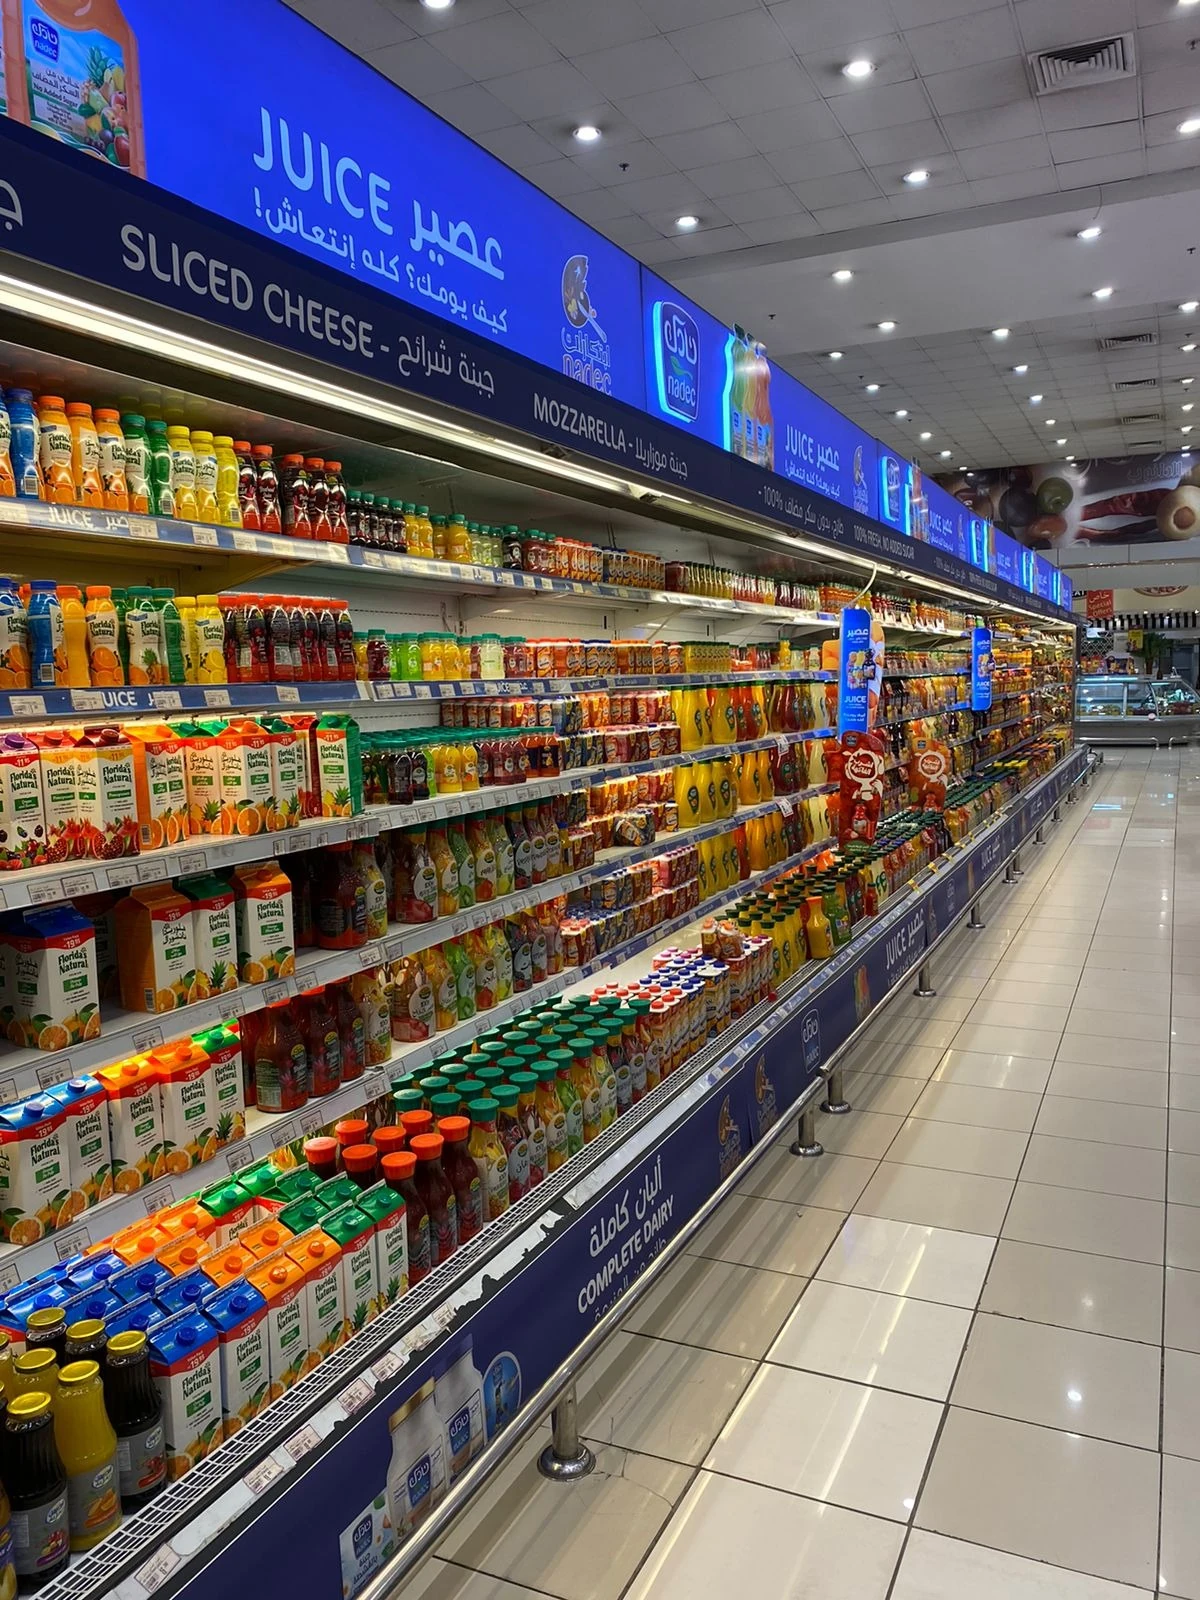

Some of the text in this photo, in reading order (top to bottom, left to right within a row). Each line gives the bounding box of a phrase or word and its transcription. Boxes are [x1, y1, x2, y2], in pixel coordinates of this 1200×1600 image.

[34, 40, 57, 57] nadec
[33, 83, 78, 108] No Added Sugar
[253, 106, 505, 280] JUICE عصير
[120, 224, 254, 311] SLICED
[362, 250, 399, 283] كله
[405, 263, 467, 320] يومك؟
[263, 283, 374, 358] CHEESE
[472, 300, 508, 334] كيف
[398, 335, 452, 377] شرائح
[458, 351, 495, 400] جبنة
[667, 375, 696, 408] nadec
[533, 393, 626, 453] MOZZARELLA
[669, 452, 688, 480] جبنة
[785, 424, 840, 472] JUICE عصير
[785, 497, 803, 518] مضاف
[804, 503, 817, 525] سكر
[49, 506, 128, 530] JUICE صير
[882, 536, 890, 551] NO
[889, 539, 903, 555] ADDED
[902, 544, 915, 560] SUGAR
[1088, 600, 1112, 611] Special
[1092, 607, 1112, 618] Offers
[89, 620, 115, 630] Florida's
[90, 627, 115, 637] Natural
[847, 628, 869, 638] عصير
[101, 690, 138, 707] UICE
[844, 695, 867, 704] JUICE
[247, 751, 268, 762] Florida's
[278, 748, 295, 758] Florida's
[320, 744, 344, 753] Florida's
[321, 752, 345, 760] Natural
[47, 767, 75, 779] Florida's
[103, 763, 131, 776] Florida's
[248, 760, 269, 769] Natural
[10, 770, 37, 782] Florida's
[48, 776, 76, 788] Natural
[104, 774, 132, 786] Natural
[11, 780, 38, 792] Natural
[257, 900, 283, 912] Florida's
[209, 912, 230, 923] Florida's
[258, 910, 284, 920] Natural
[209, 921, 230, 932] Natural
[886, 928, 907, 970] JUICE
[907, 908, 925, 947] عصير
[58, 951, 87, 965] Florida's
[60, 960, 88, 975] Natural
[215, 1063, 236, 1078] Florida's
[216, 1070, 237, 1086] Natural
[181, 1082, 205, 1097] Florida's
[182, 1089, 206, 1105] Natural
[130, 1097, 153, 1113] Florida's
[131, 1104, 154, 1122] Natural
[76, 1115, 101, 1133] Florida's
[76, 1124, 102, 1141] Natural
[31, 1138, 59, 1157] Florida's
[32, 1146, 60, 1166] Natural
[635, 1155, 662, 1220] ألبان
[229, 1220, 248, 1234] Florida's
[590, 1189, 629, 1258] كاملة
[385, 1227, 402, 1244] Florida's
[386, 1234, 403, 1251] Natural
[351, 1247, 370, 1267] Florida's
[578, 1228, 643, 1314] COMPLETE
[643, 1194, 674, 1244] DAIRY
[352, 1254, 371, 1275] Natural
[315, 1274, 336, 1295] Florida's
[316, 1282, 337, 1304] Natural
[277, 1301, 299, 1322] Florida's
[278, 1308, 300, 1332] Natural
[236, 1333, 261, 1355] Florida's
[238, 1340, 262, 1366] Natural
[182, 1366, 211, 1390] Florida's
[183, 1374, 212, 1400] Natural
